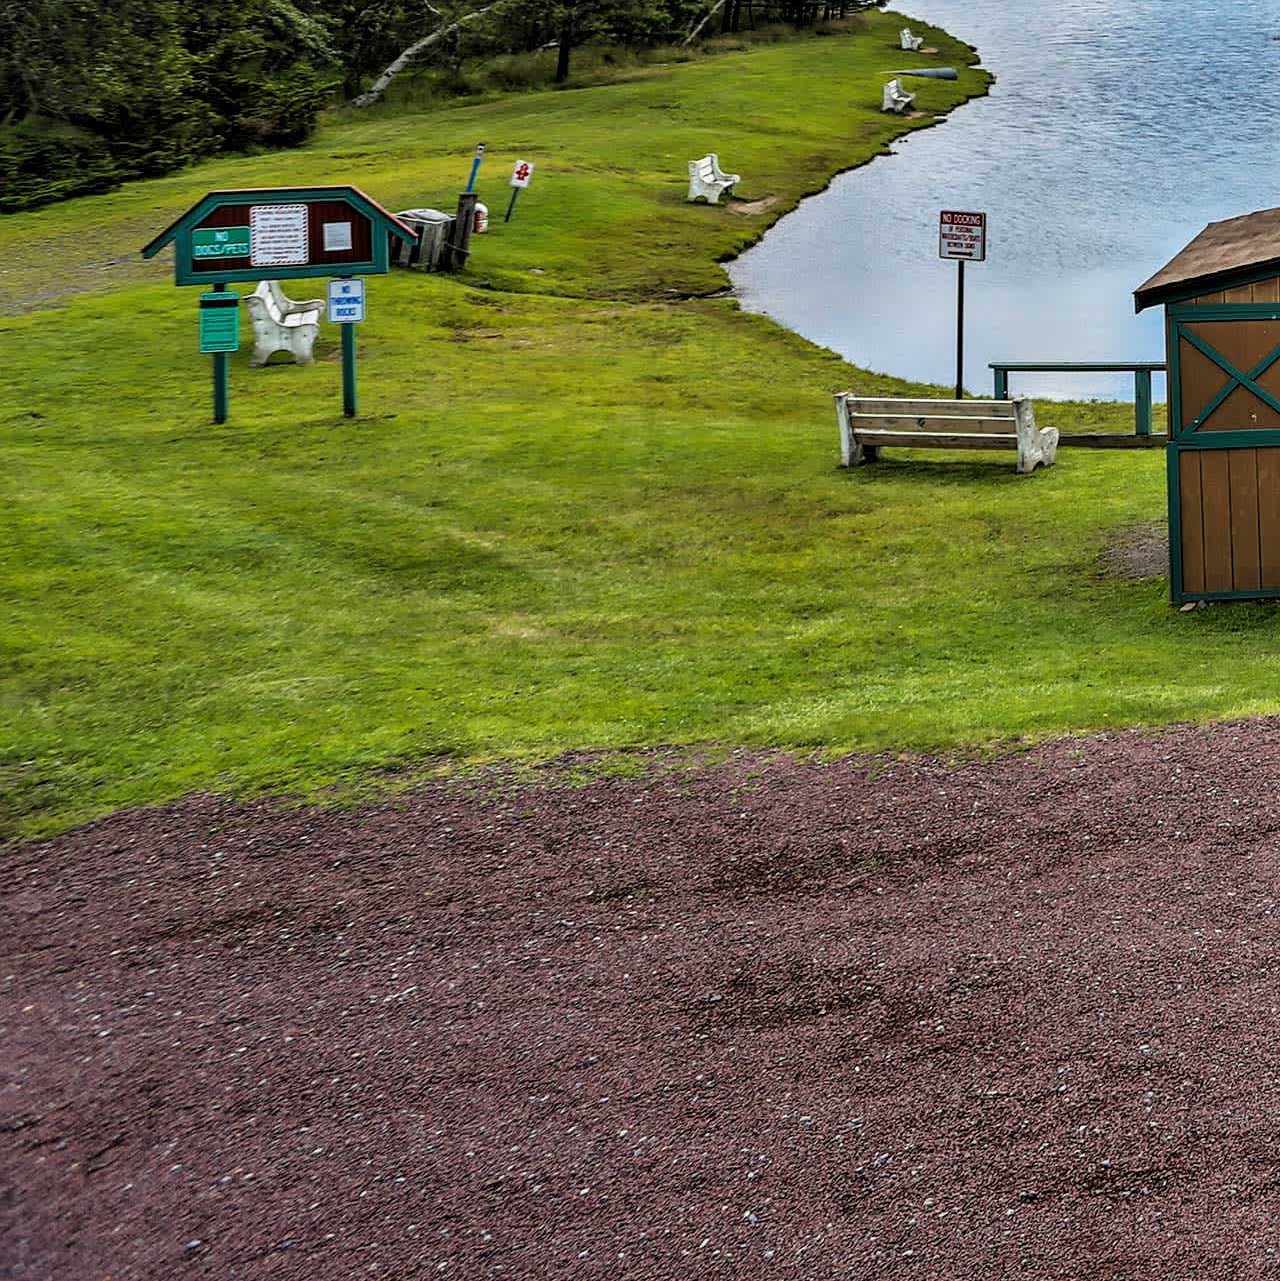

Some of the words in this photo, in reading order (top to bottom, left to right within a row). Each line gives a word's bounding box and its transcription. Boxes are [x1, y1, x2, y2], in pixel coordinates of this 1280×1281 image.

[943, 214, 952, 223] NO
[953, 215, 981, 225] DOCKING
[215, 231, 229, 242] NO
